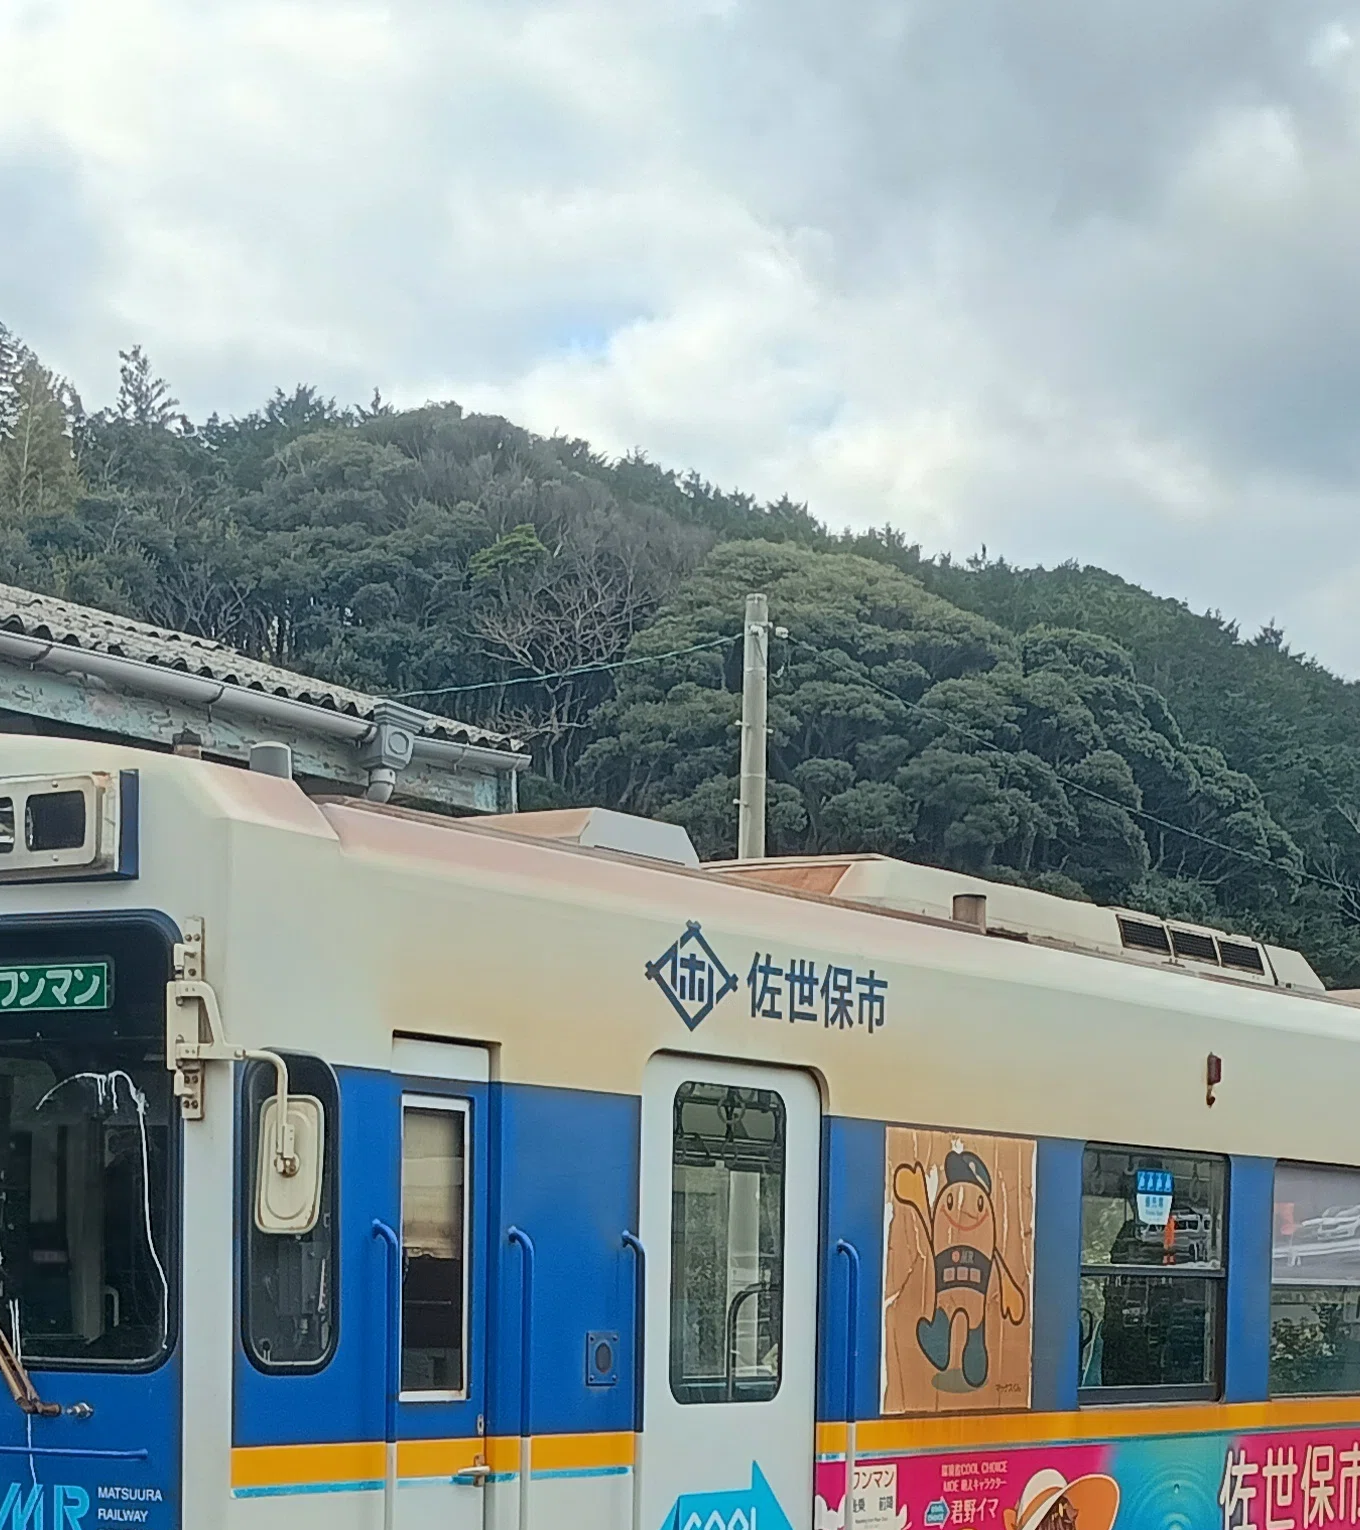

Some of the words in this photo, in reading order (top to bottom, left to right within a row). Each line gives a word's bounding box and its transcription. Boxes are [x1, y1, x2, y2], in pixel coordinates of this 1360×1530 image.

[746, 950, 889, 1034] 佐世保市
[97, 1486, 163, 1502] MATSUURA
[97, 1508, 149, 1523] RAILWAY
[951, 1497, 999, 1524] 君野イマ
